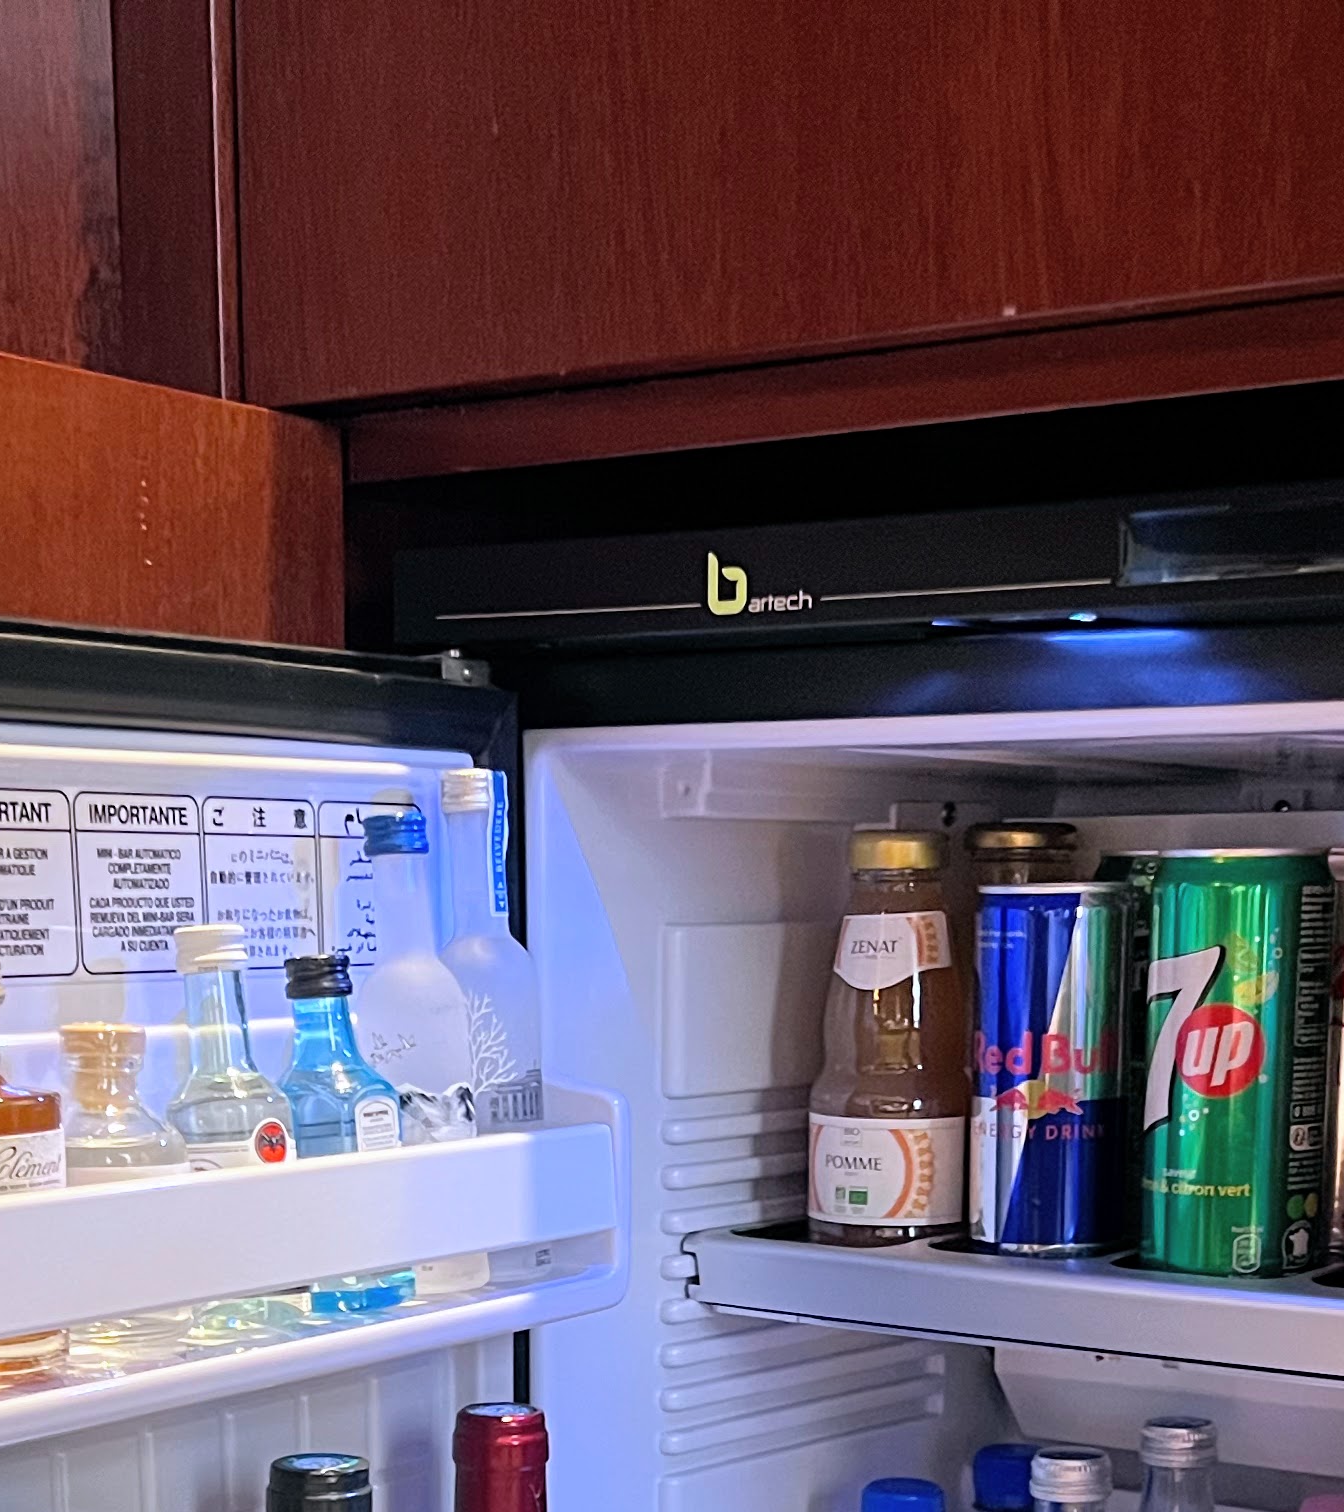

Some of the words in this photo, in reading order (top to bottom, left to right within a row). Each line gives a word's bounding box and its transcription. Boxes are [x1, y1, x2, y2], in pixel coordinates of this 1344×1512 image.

[89, 804, 188, 826] IMPORTANTE
[212, 806, 307, 830] ご注意
[13, 848, 48, 860] GESTION
[118, 848, 133, 859] BAR
[108, 862, 171, 875] COMPLETAMENTE
[19, 899, 54, 911] PRODUIT
[89, 897, 110, 908] CADA
[112, 897, 154, 908] PRODUCTO
[155, 897, 170, 908] QUE
[171, 897, 195, 908] USTED
[127, 912, 141, 923] DEL
[139, 940, 169, 952] CUENTA
[850, 940, 898, 955] ZENAT
[825, 1154, 883, 1171] POMME
[1217, 1183, 1251, 1197] vert
